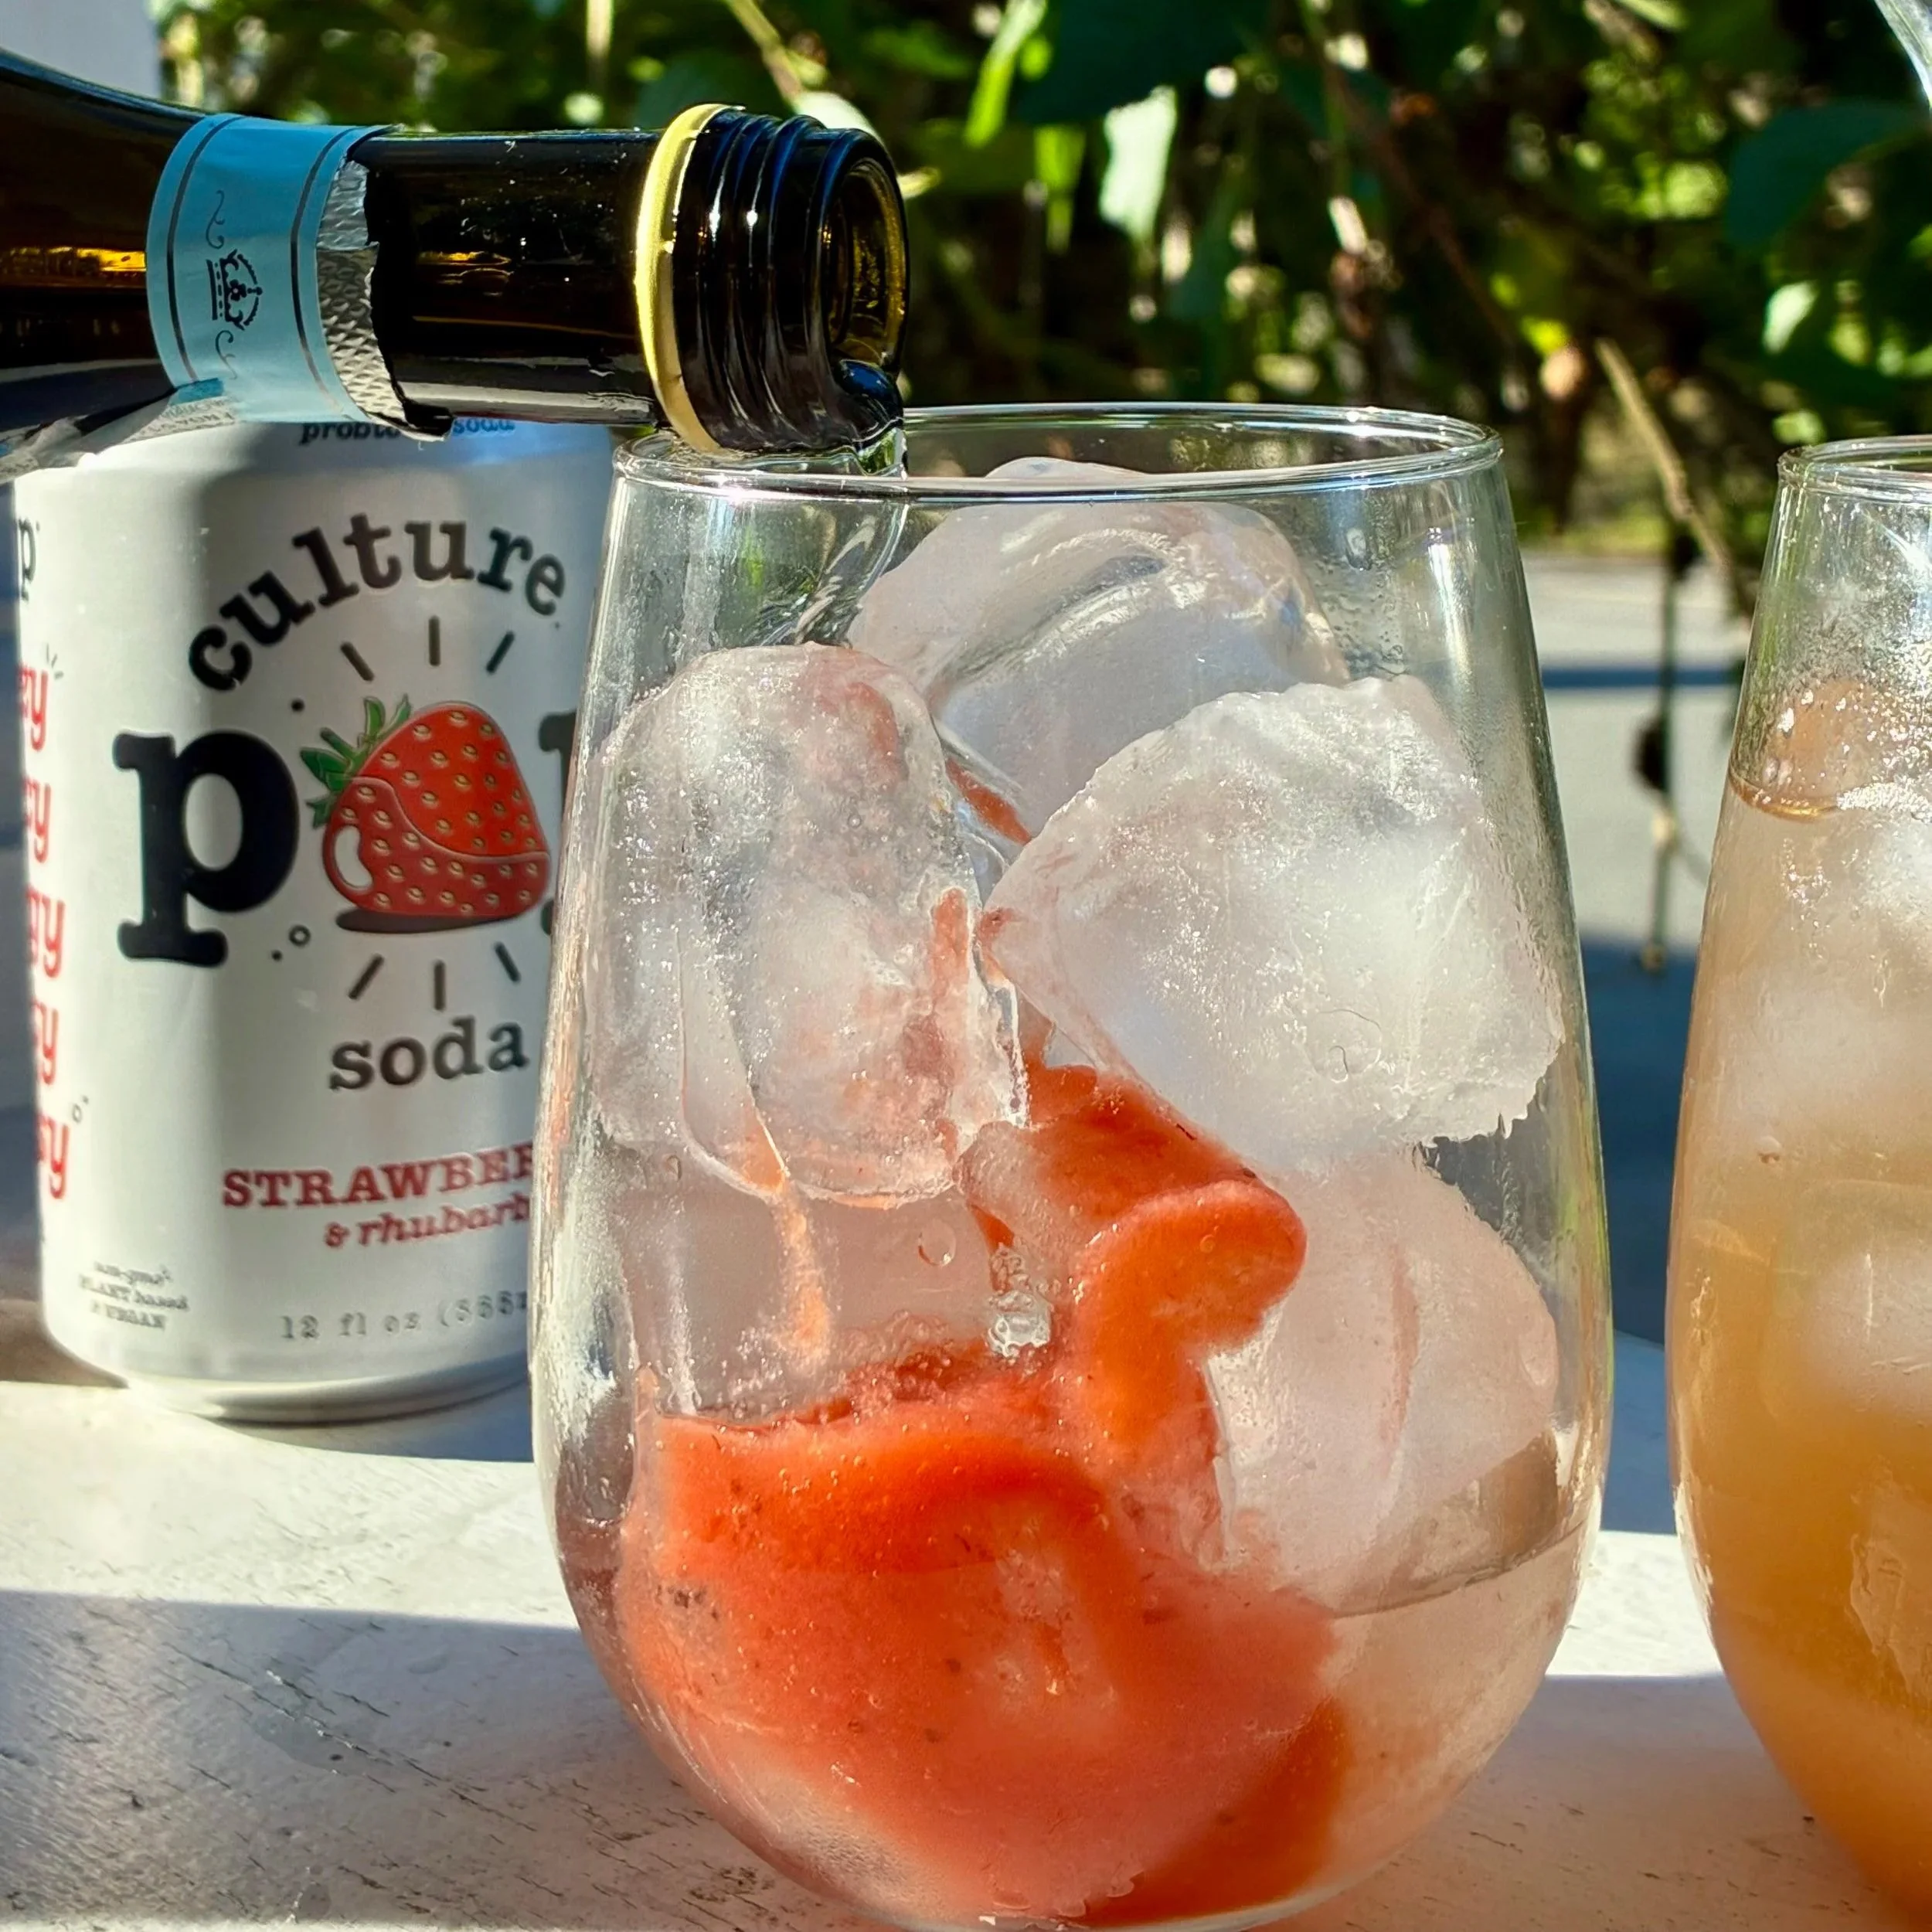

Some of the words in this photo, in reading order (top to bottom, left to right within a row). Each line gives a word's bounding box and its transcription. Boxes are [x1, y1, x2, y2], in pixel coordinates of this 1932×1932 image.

[189, 513, 565, 692] culture
[329, 1015, 530, 1090] soda
[222, 1142, 532, 1208] STRAWBER
[281, 1315, 320, 1339] 12
